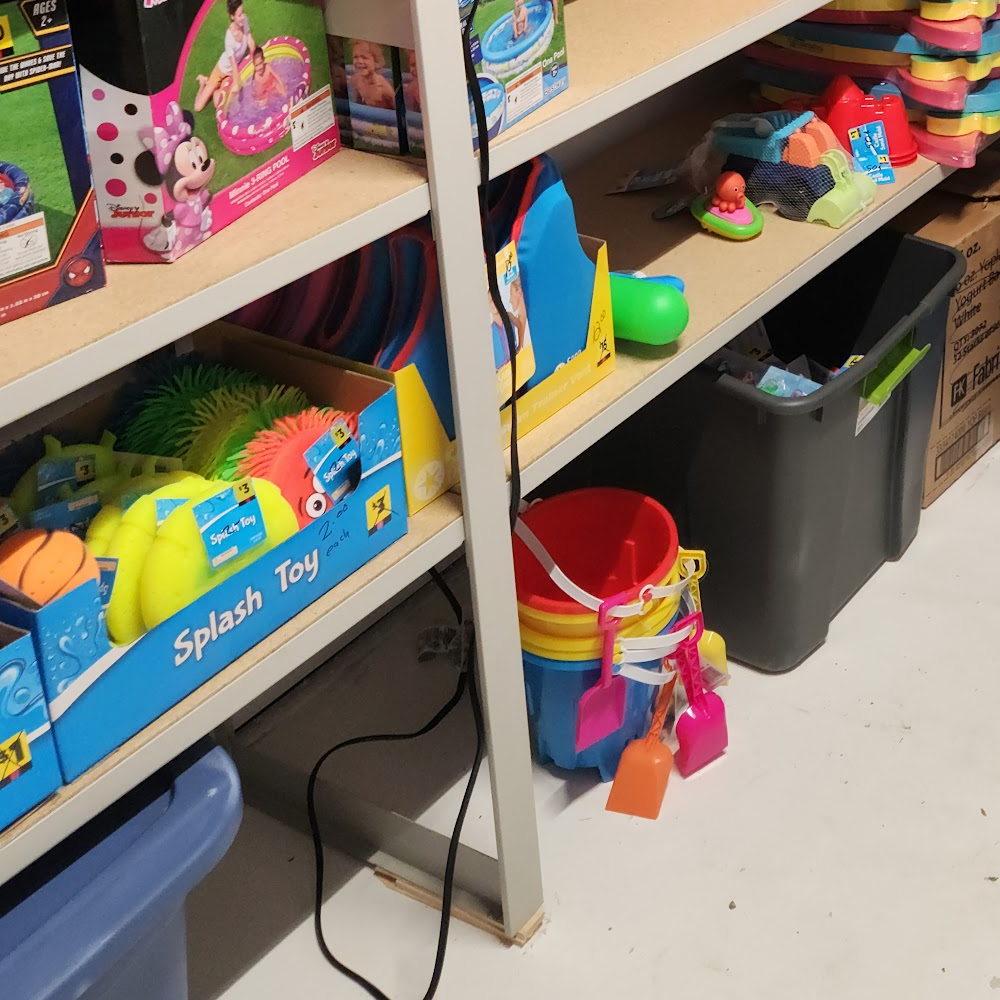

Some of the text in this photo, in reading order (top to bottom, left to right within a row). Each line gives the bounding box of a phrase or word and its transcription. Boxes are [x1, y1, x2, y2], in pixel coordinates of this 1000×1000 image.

[41, 14, 53, 28] 2+
[542, 48, 565, 69] One Pool
[954, 301, 983, 330] White
[238, 482, 251, 495] $3
[173, 548, 321, 669] Splash Toy
